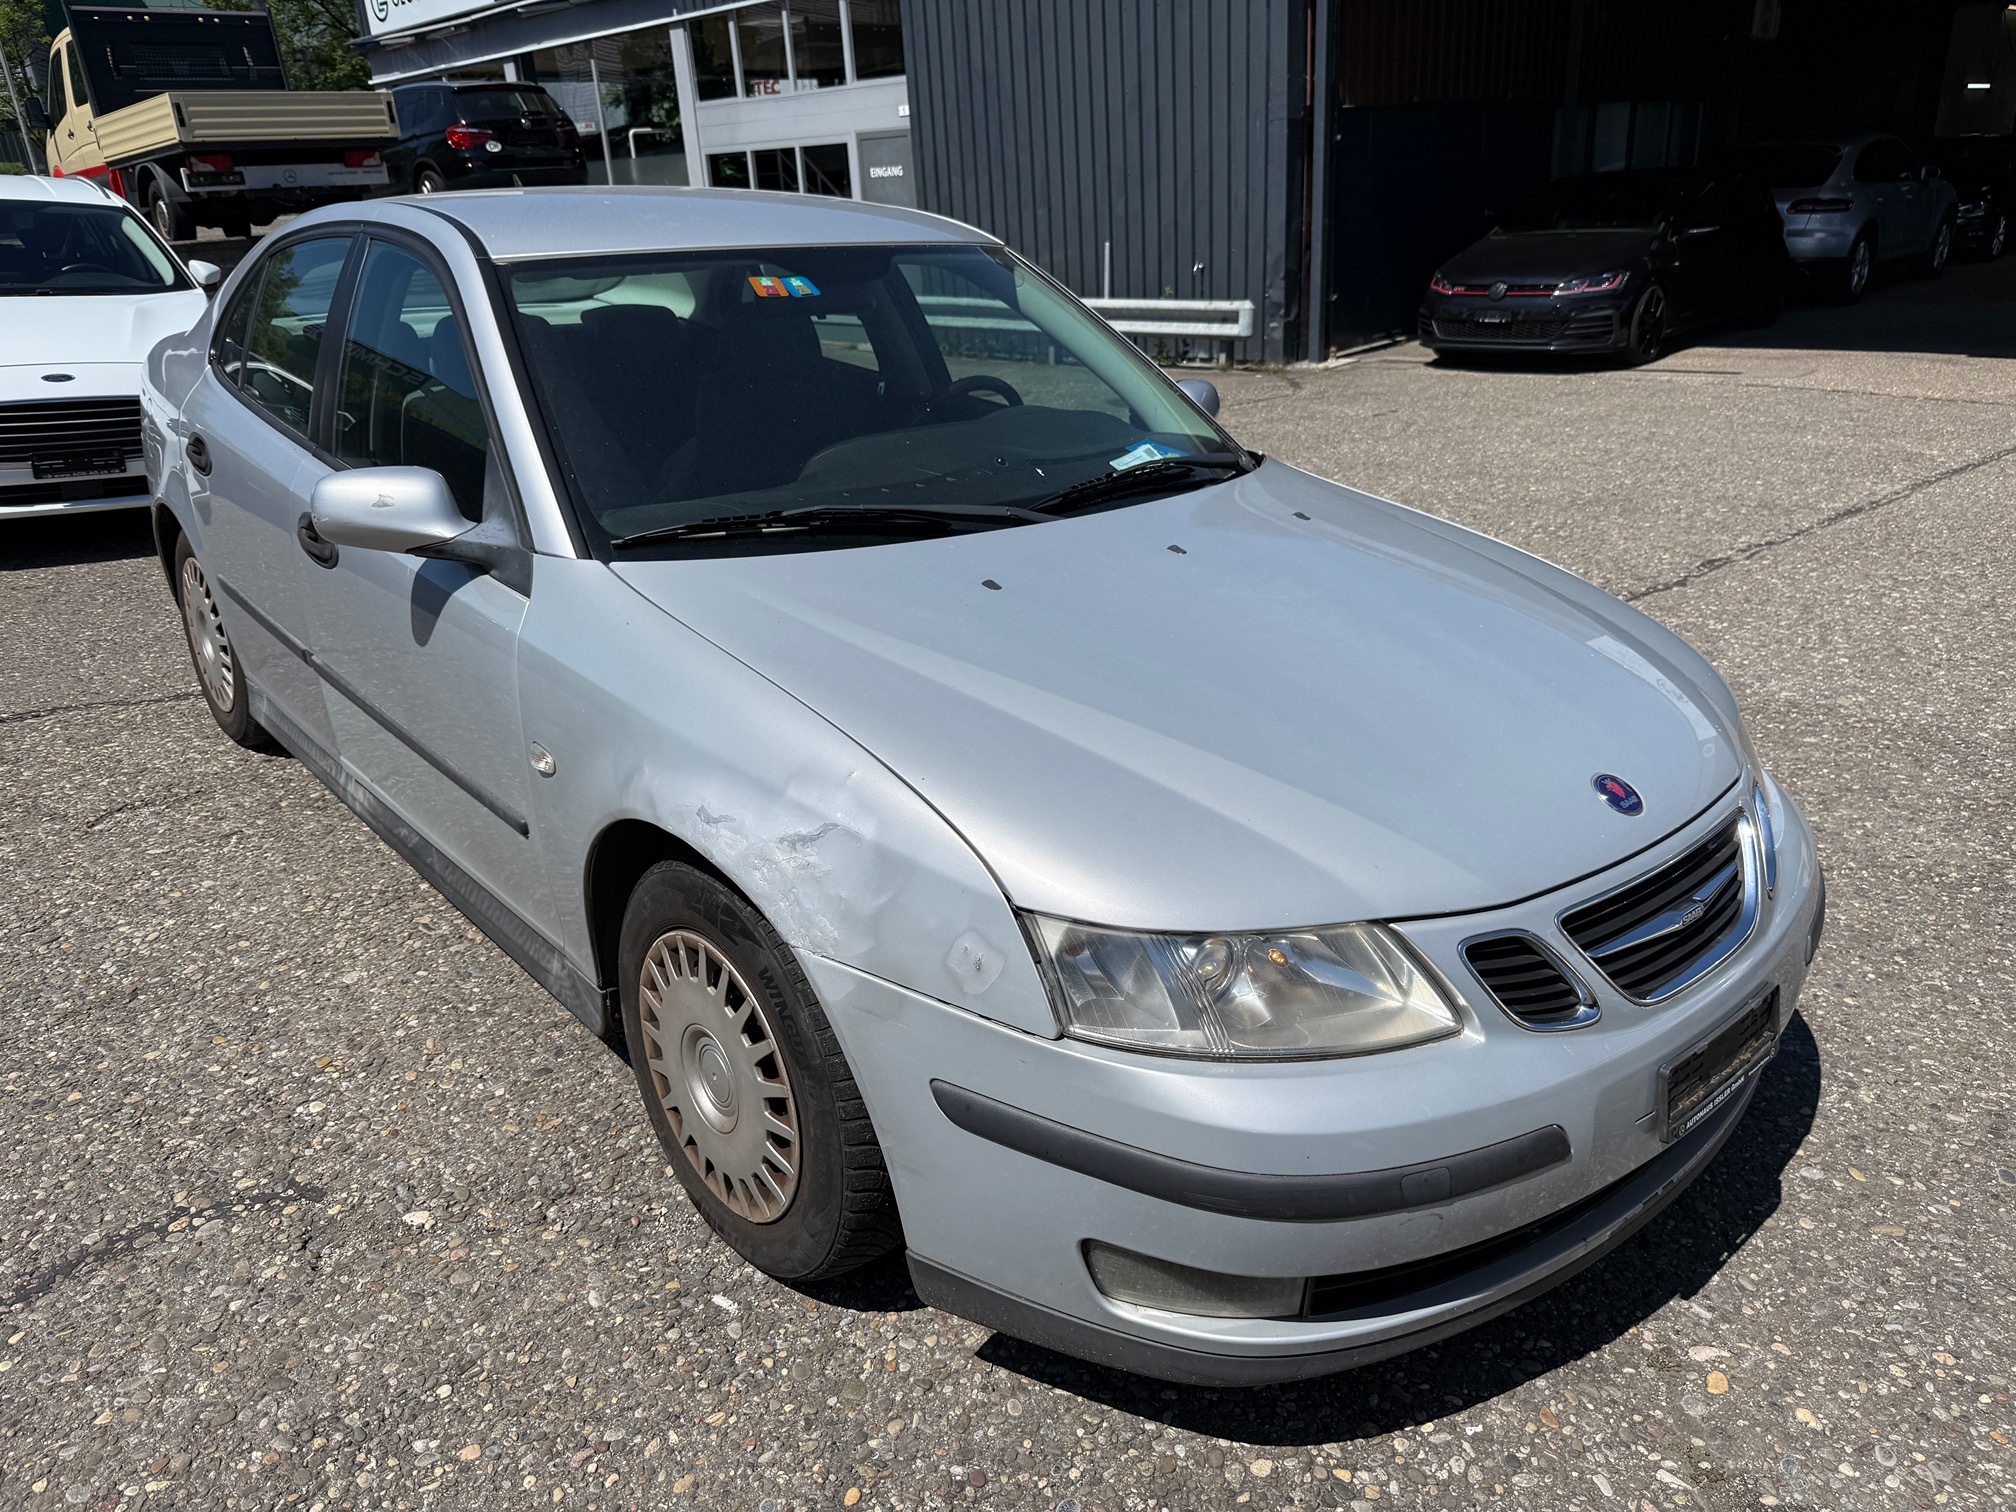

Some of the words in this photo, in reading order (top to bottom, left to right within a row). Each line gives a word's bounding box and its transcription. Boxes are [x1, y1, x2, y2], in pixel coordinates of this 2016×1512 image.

[869, 166, 904, 178] EINGANG
[1619, 795, 1640, 809] SAAB
[1682, 907, 1702, 926] SAAB
[1685, 1101, 1714, 1130] AUTOHAUS
[1713, 1088, 1731, 1107] ISSLER
